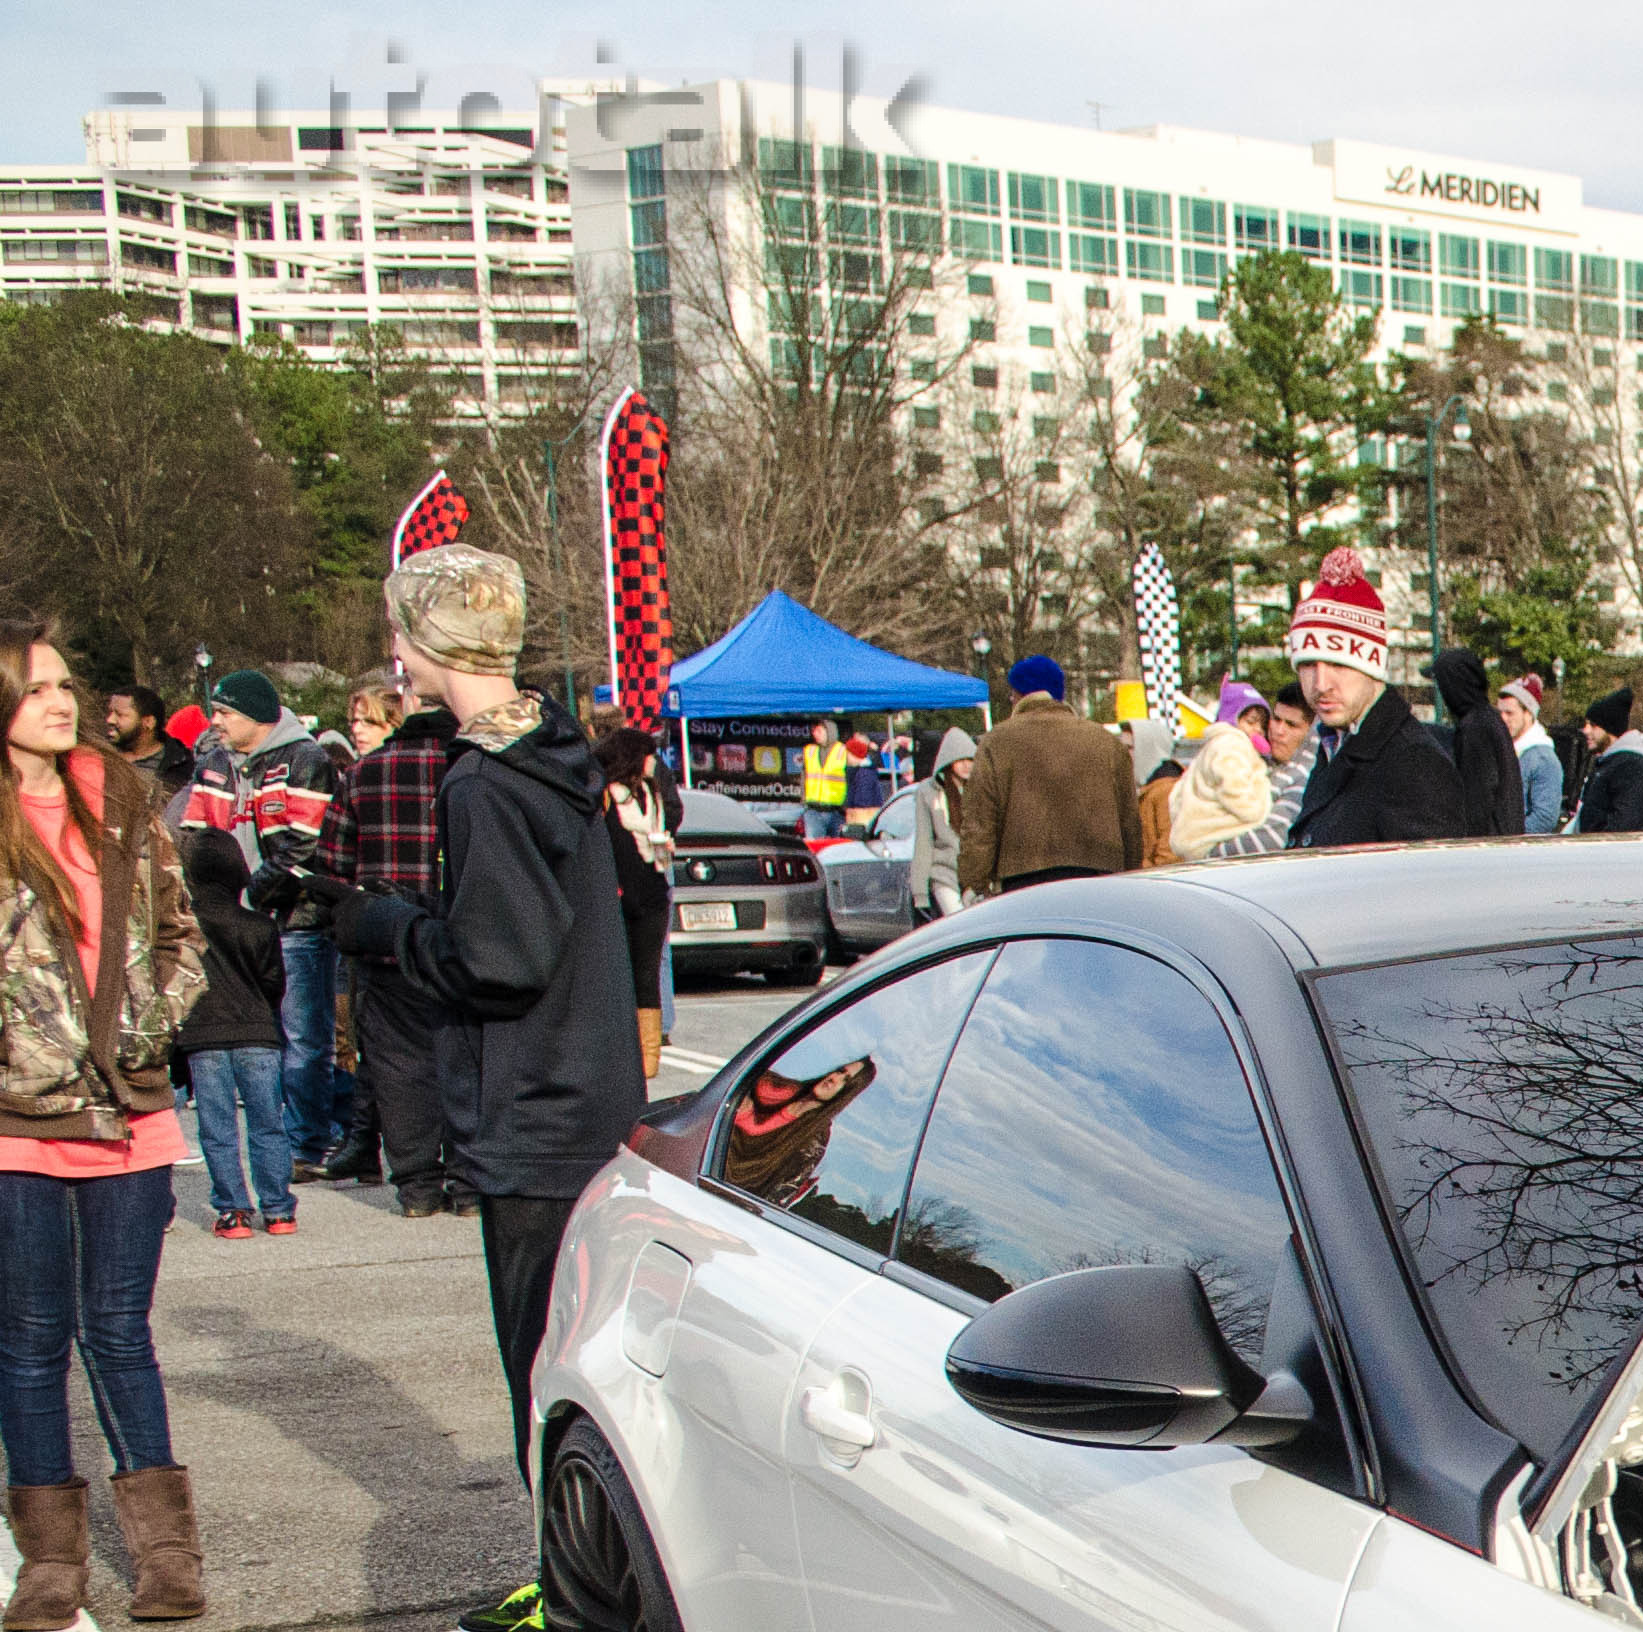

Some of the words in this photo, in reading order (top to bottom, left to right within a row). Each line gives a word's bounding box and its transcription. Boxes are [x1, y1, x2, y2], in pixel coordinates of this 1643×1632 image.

[1385, 165, 1415, 195] Le
[1419, 169, 1541, 214] MERIDIEN
[690, 719, 725, 738] Stay
[729, 720, 811, 738] Connected
[697, 780, 804, 797] CaffeineandOcta
